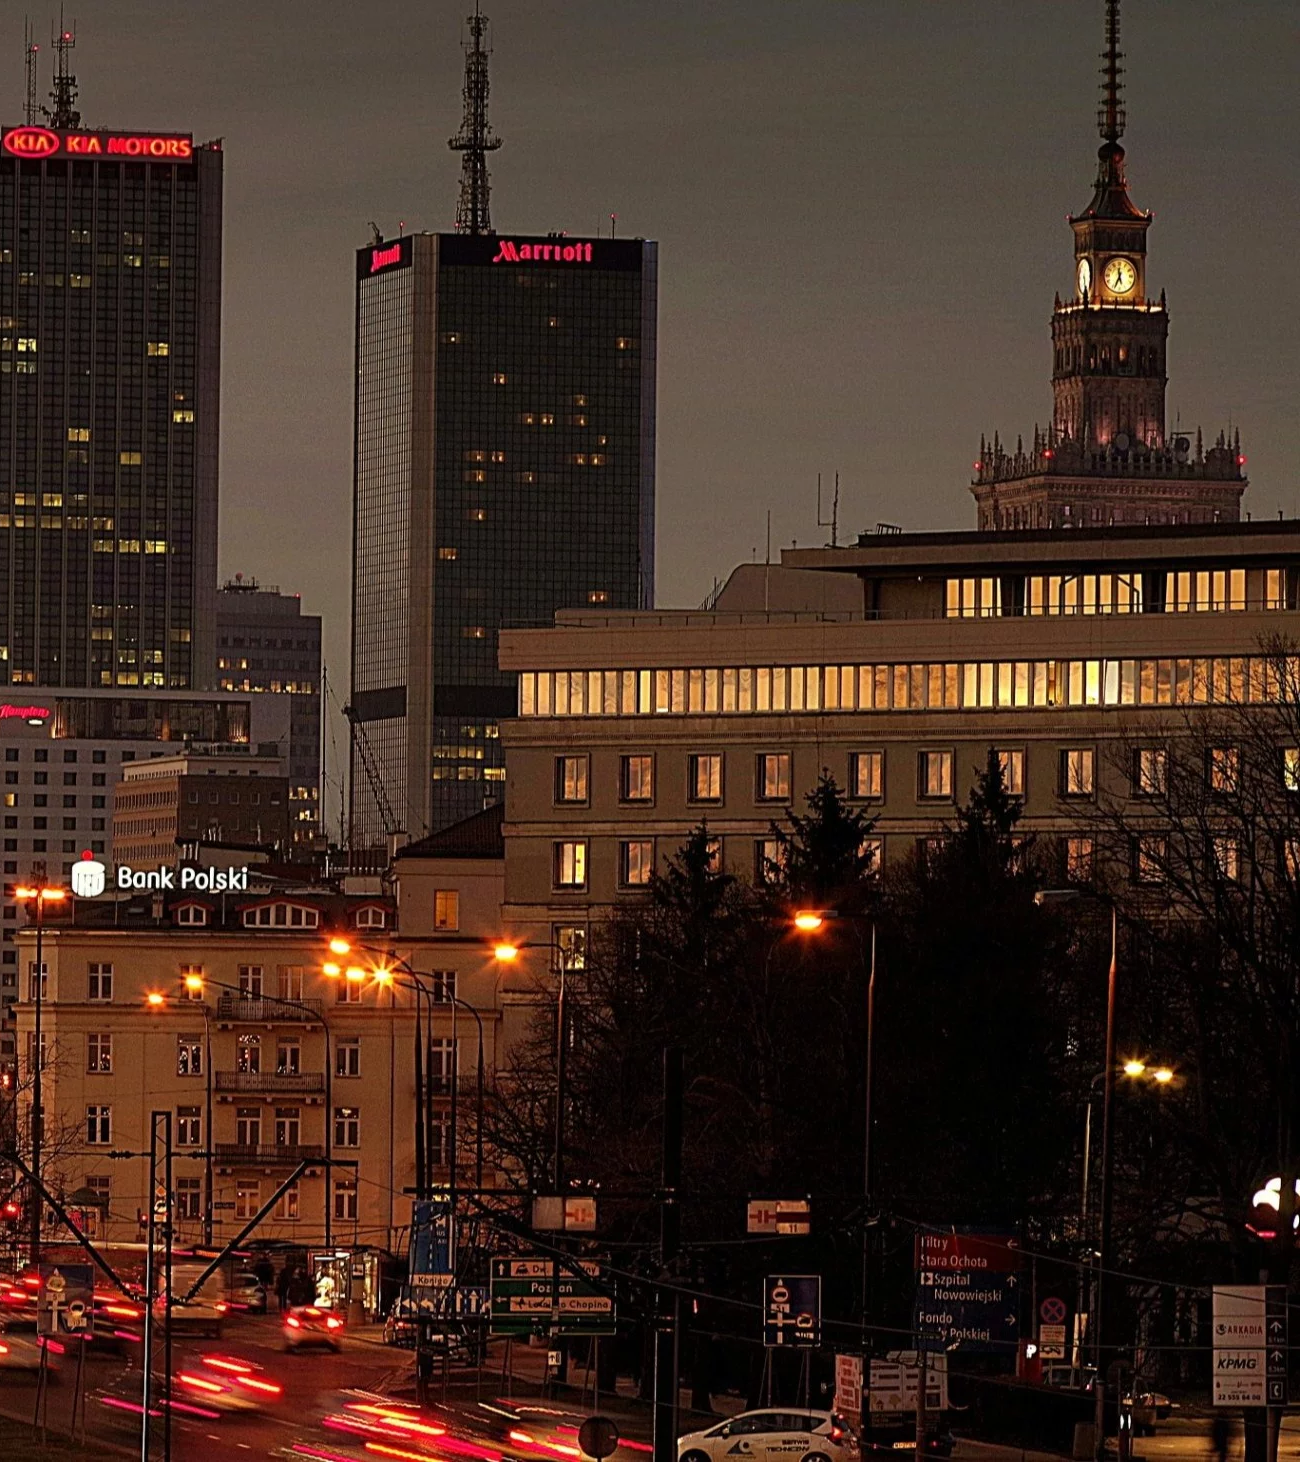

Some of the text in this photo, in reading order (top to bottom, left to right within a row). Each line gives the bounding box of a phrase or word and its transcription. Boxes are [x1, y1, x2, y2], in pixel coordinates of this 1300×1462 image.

[13, 134, 50, 151] KIA
[66, 135, 191, 157] KIA MOTORS
[492, 240, 592, 262] Marriott
[118, 866, 248, 890] Bank Polski
[950, 1254, 988, 1268] Ochota
[531, 1282, 573, 1293] Pozań
[934, 1272, 971, 1288] Szpital
[934, 1288, 1002, 1304] Nowowiejski
[569, 1300, 609, 1311] Chopina
[1227, 1325, 1263, 1335] ARKADIA
[1217, 1358, 1257, 1370] KPMG
